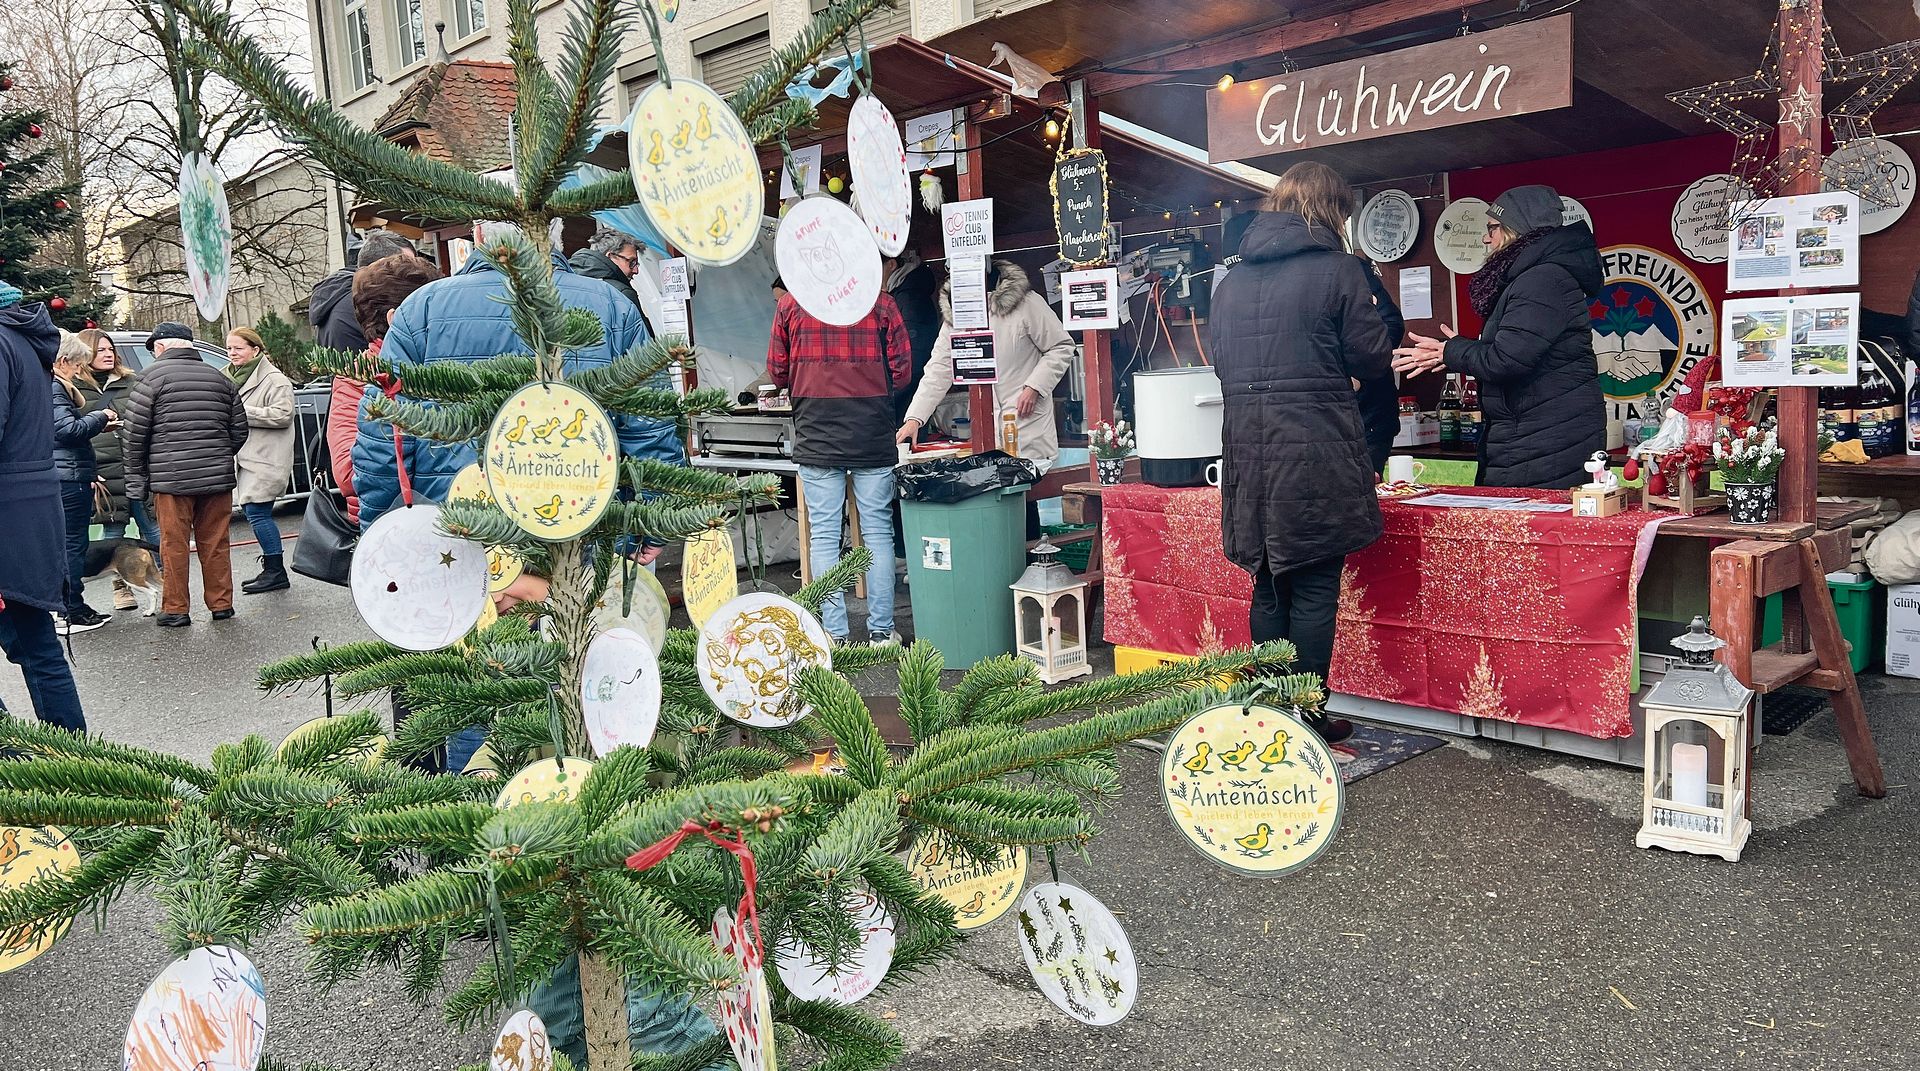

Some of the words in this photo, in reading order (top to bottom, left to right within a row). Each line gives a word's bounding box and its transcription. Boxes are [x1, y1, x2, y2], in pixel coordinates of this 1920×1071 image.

[1255, 43, 1512, 146] Glühwein
[1060, 163, 1097, 180] Glühwein
[1695, 190, 1713, 198] wenn
[1066, 194, 1093, 212] Punsch
[965, 209, 989, 222] TENNIS
[1861, 206, 1877, 216] ACH
[795, 216, 822, 241] GRUPPE
[965, 222, 982, 234] CLUB
[951, 235, 987, 247] ENTFELDEN
[1694, 234, 1729, 248] Mande
[671, 265, 685, 275] TENNIS
[671, 275, 682, 284] CLUB
[506, 451, 600, 479] Äntenäscht
[1190, 782, 1319, 807] Äntenäscht
[1196, 810, 1240, 822] spielend
[1243, 809, 1274, 820] leben
[1278, 808, 1315, 820] lernen
